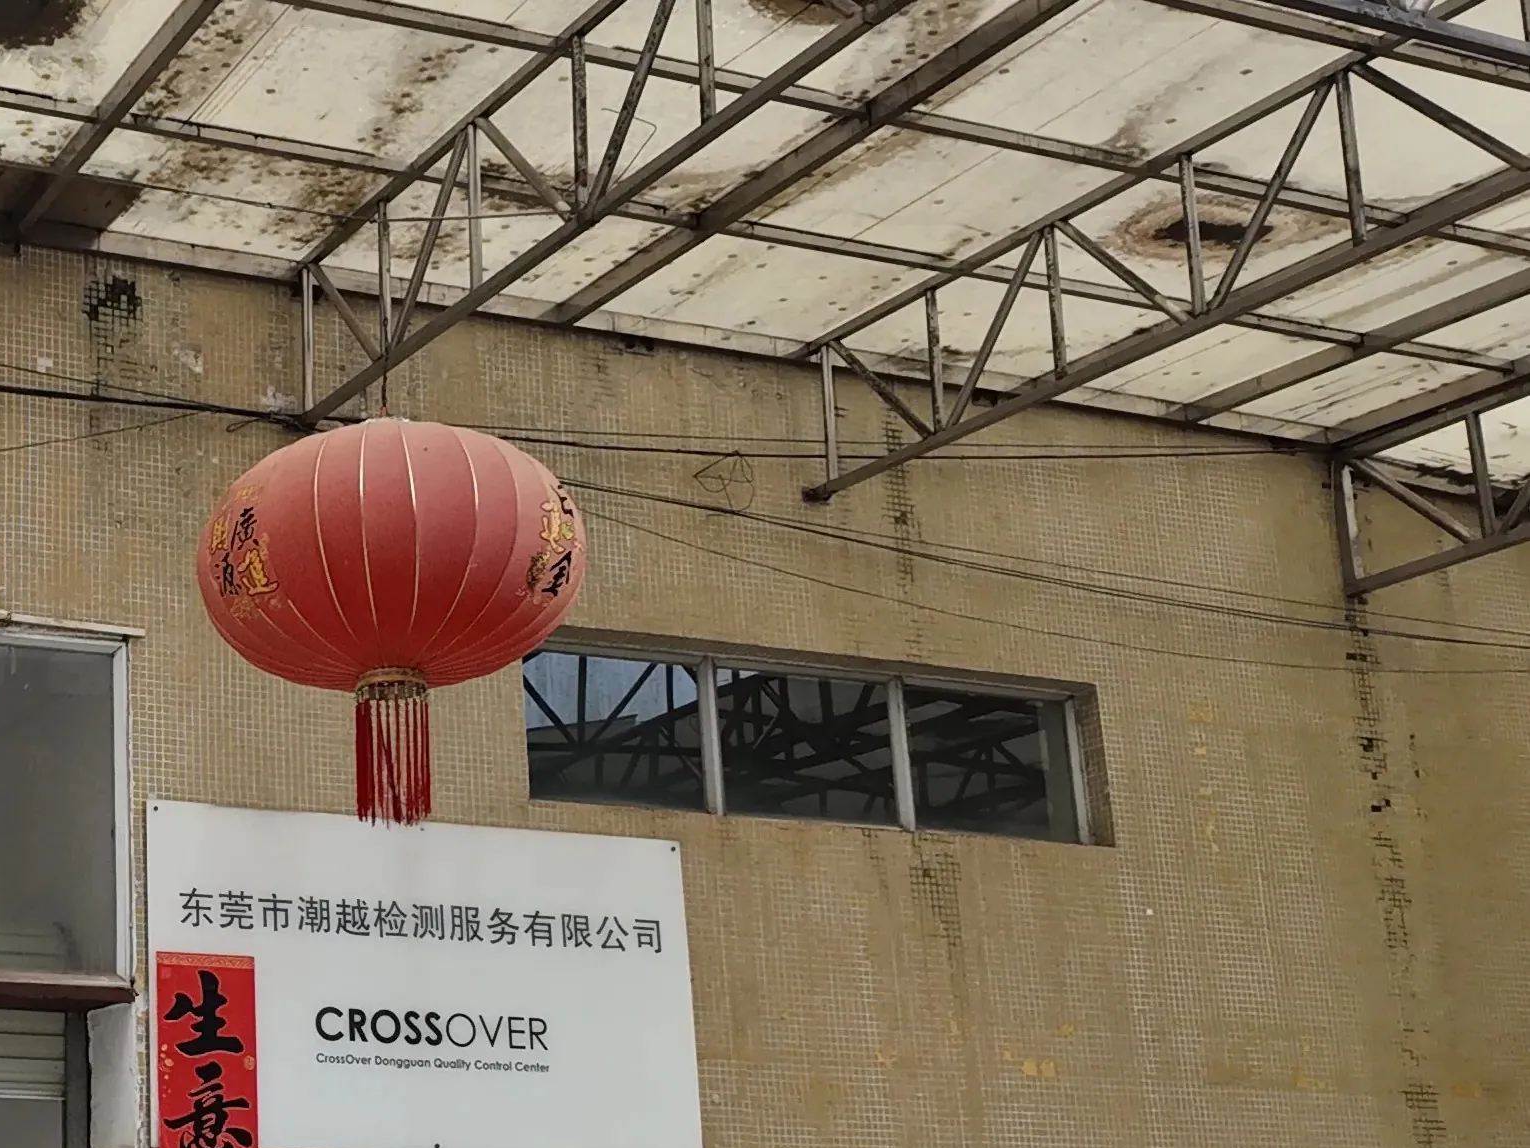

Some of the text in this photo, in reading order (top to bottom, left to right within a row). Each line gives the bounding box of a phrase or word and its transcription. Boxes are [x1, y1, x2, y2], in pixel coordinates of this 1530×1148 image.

[179, 888, 662, 953] 东莞市潮越检测服务有限公司
[315, 1006, 548, 1051] CROSSOVER
[316, 1053, 550, 1073] CrossOver Dongguan Quality Control Center
